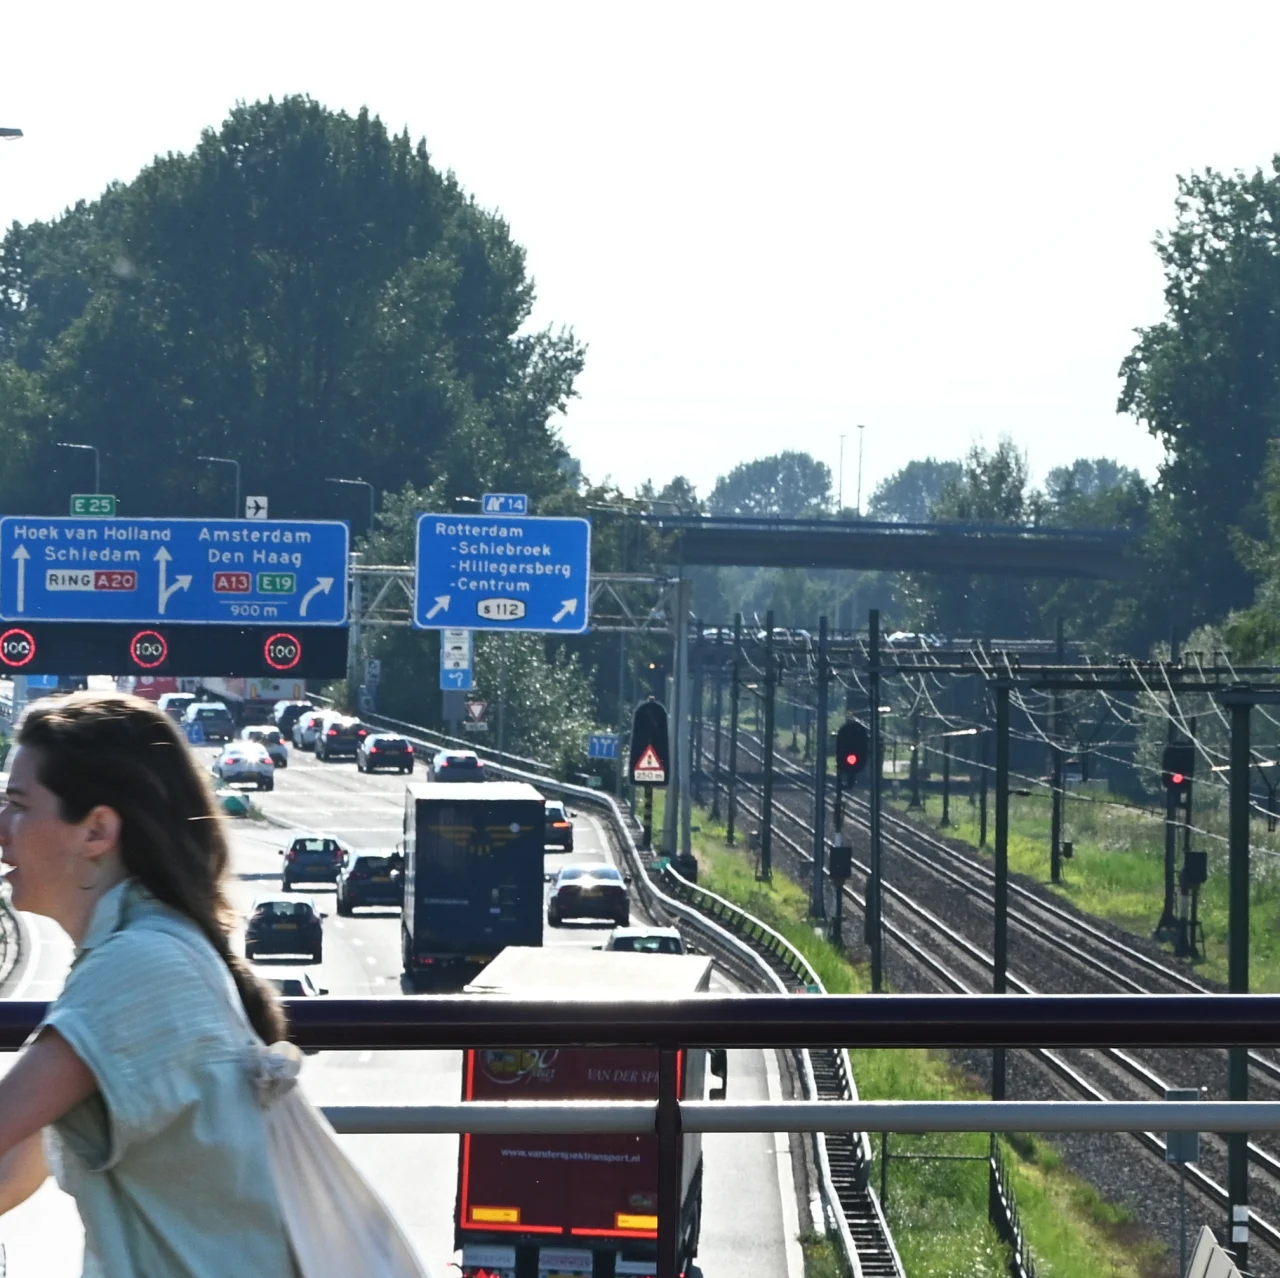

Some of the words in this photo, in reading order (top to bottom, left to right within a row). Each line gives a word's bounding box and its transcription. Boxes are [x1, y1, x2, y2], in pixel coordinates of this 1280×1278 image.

[74, 500, 85, 512] E
[89, 500, 111, 512] 25
[508, 500, 523, 510] 14
[14, 525, 58, 540] Hoek
[65, 529, 97, 540] van
[104, 527, 171, 541] Holland
[198, 527, 312, 543] Amsterdam
[436, 523, 523, 537] Rotterdam
[45, 546, 140, 561] Schiedam
[208, 549, 244, 563] Den
[253, 550, 302, 568] Haag
[49, 575, 90, 586] RING
[97, 575, 133, 587] A20
[217, 577, 248, 589] A13
[263, 577, 292, 589] E19
[230, 605, 260, 616] 900
[264, 606, 278, 616] m
[496, 604, 518, 616] 112
[3, 641, 30, 654] 100
[135, 643, 162, 655] 100
[269, 645, 296, 658] 100
[588, 1068, 610, 1080] VAN
[613, 1070, 638, 1082] DER
